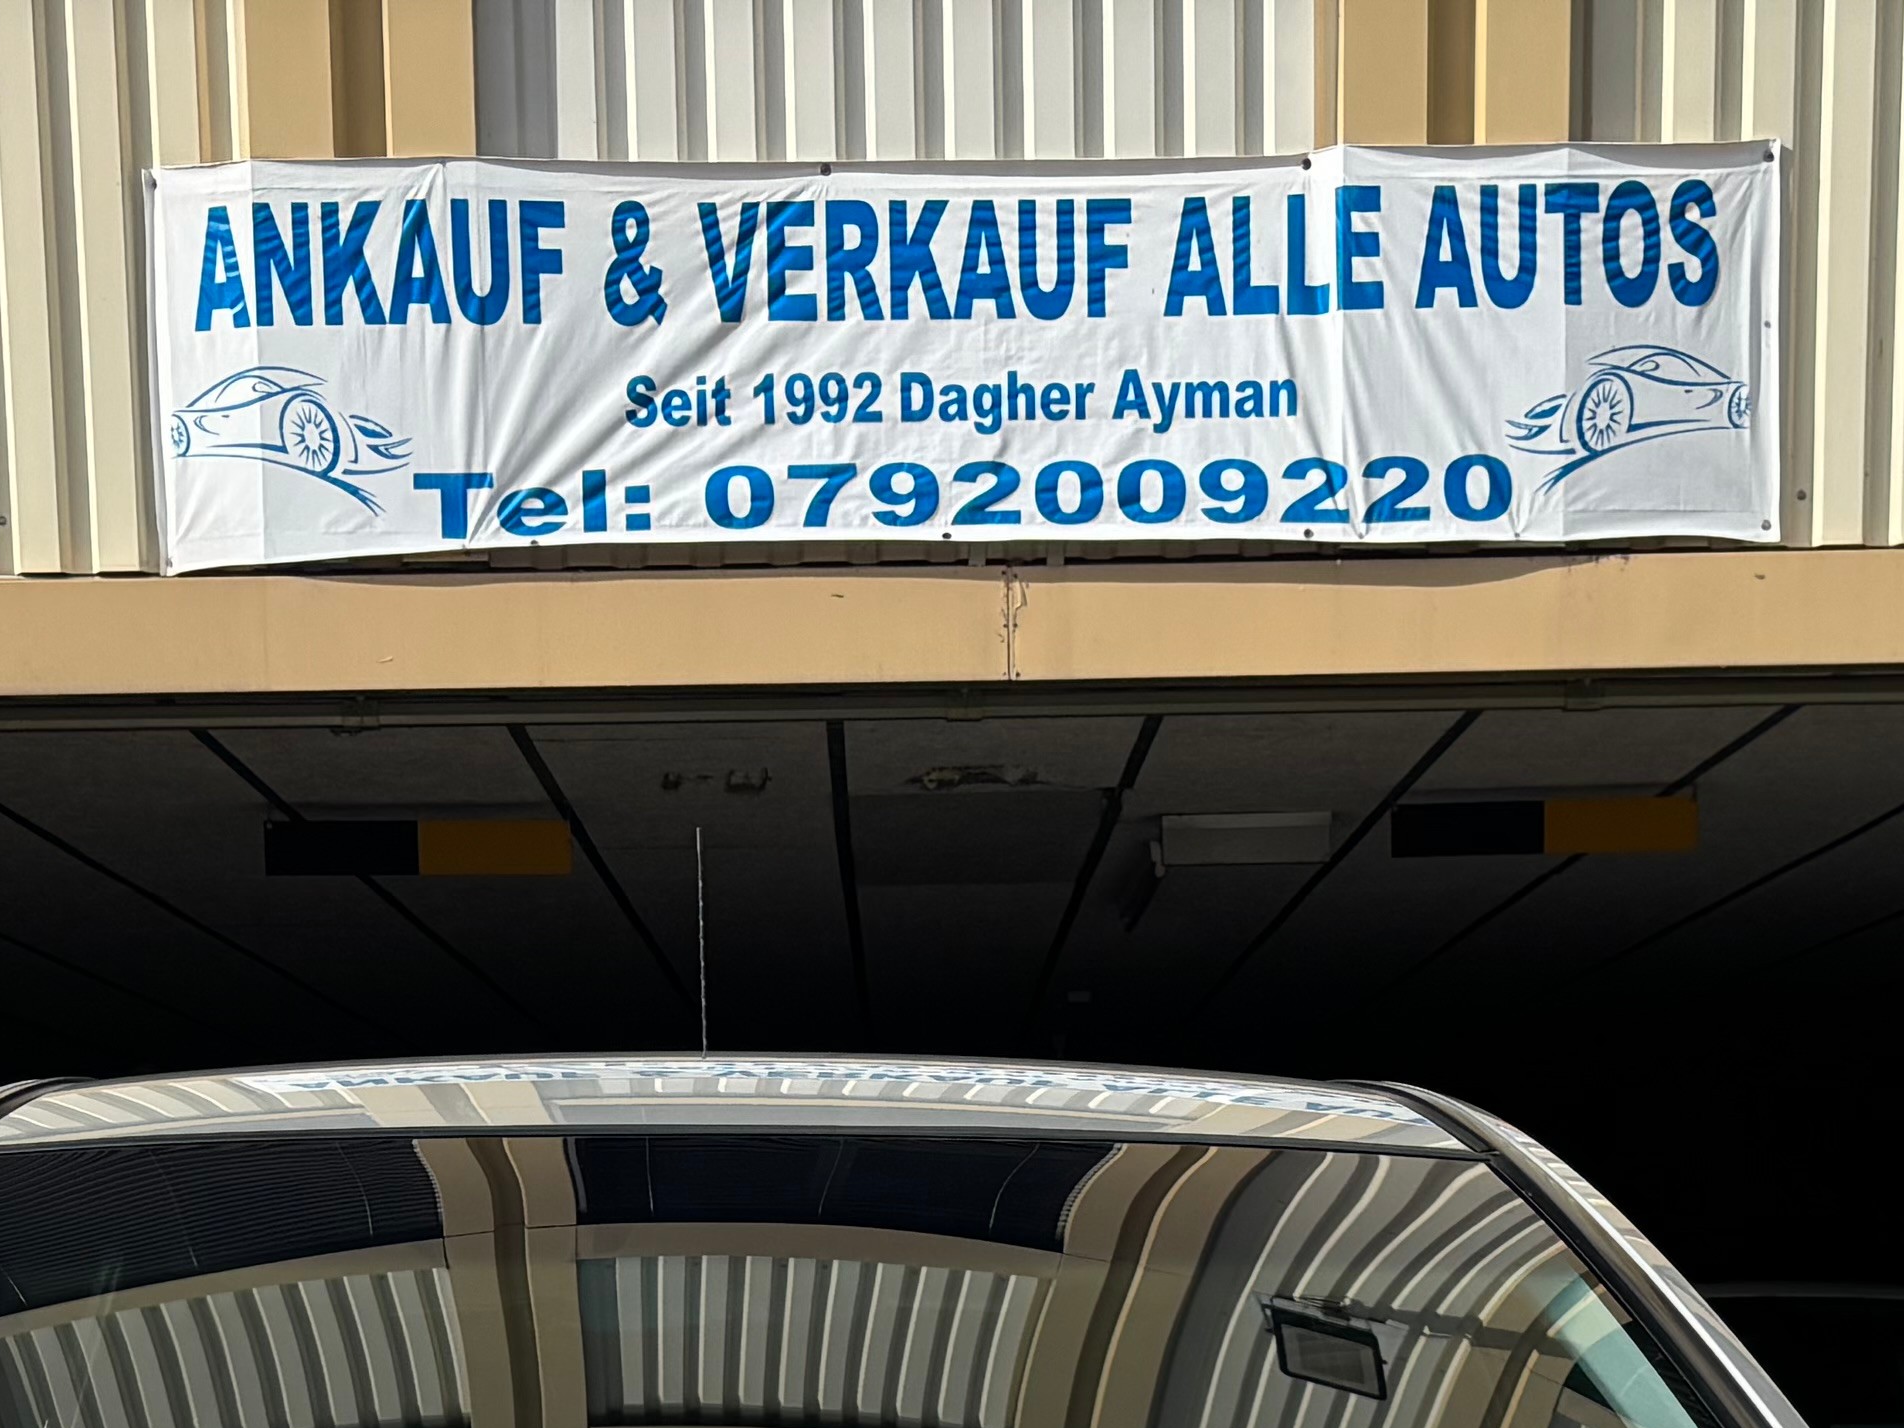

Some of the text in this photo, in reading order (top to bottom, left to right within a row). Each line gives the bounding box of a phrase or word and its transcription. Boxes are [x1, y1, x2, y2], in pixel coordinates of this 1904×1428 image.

[195, 179, 1721, 333] ANKAUF & VERKAUF ALLE AUTOS
[626, 368, 1297, 435] Seit 1992 Dagher Ayman
[413, 455, 1513, 541] Tel: 0792009220
